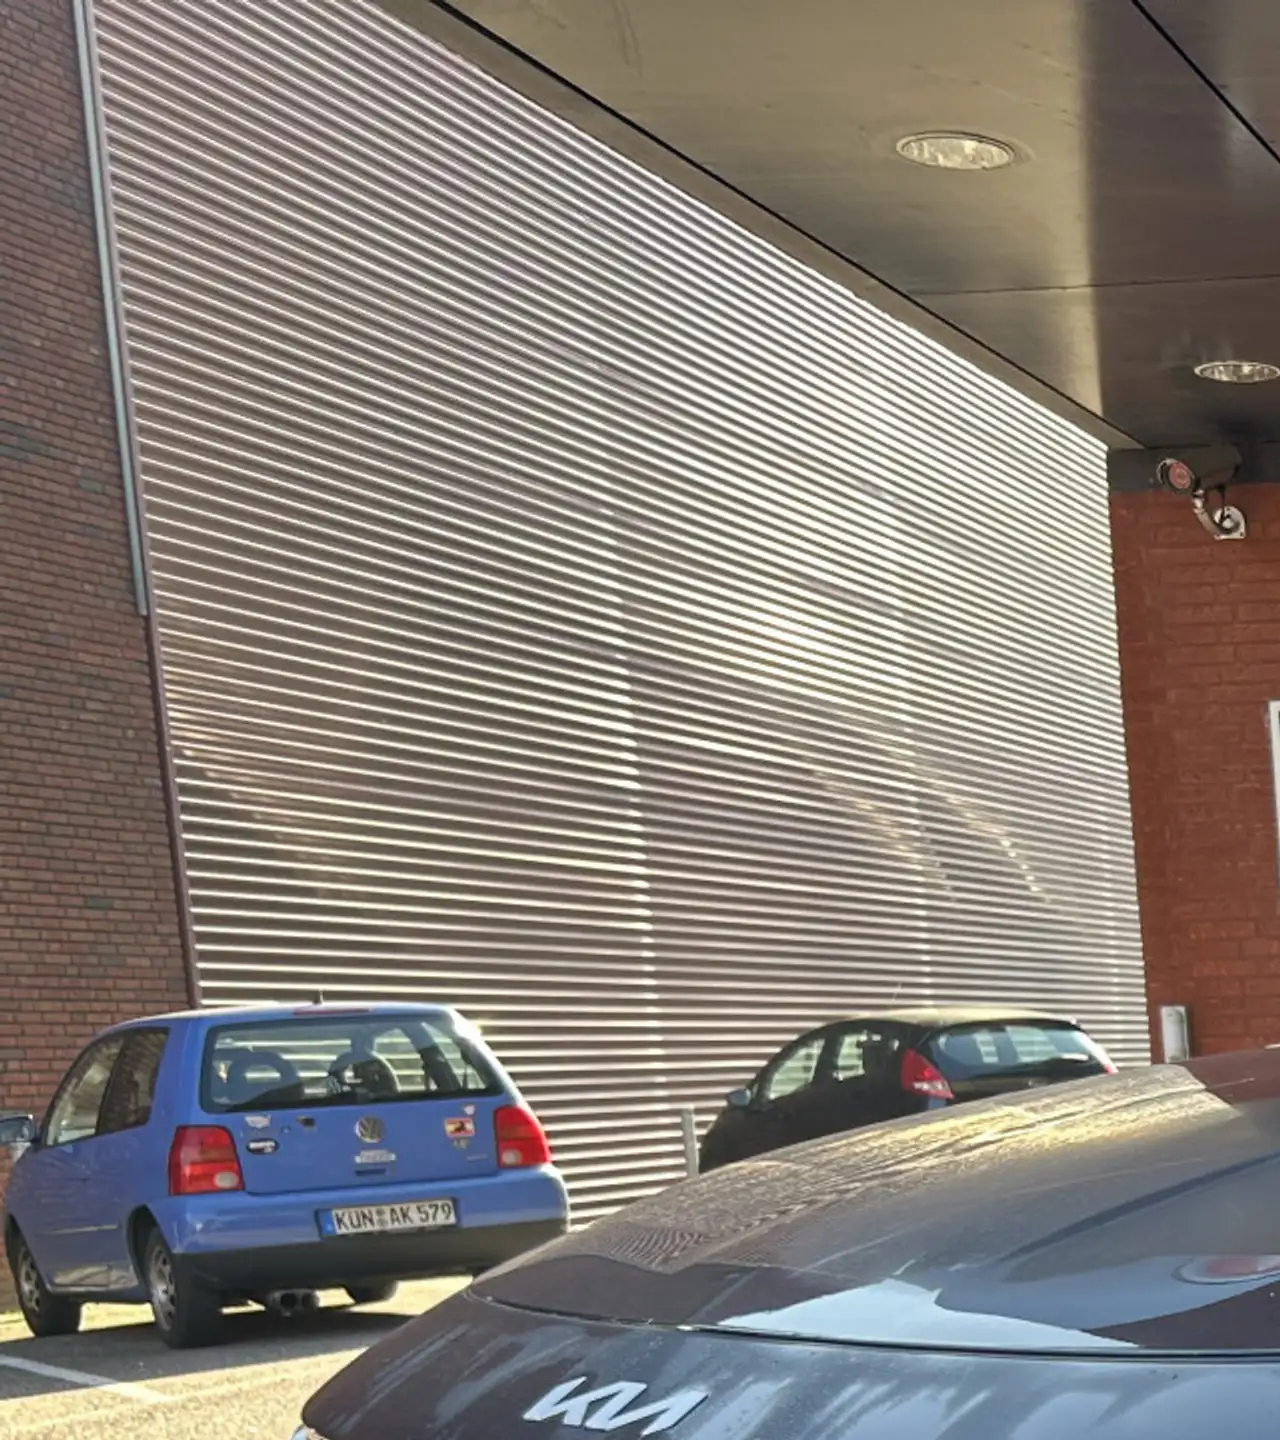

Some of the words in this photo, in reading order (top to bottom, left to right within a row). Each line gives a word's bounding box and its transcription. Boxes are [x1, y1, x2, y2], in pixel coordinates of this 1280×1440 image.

[335, 1209, 376, 1232] KUN
[389, 1205, 414, 1225] AK
[416, 1202, 452, 1222] 579
[522, 1374, 710, 1438] KIA
